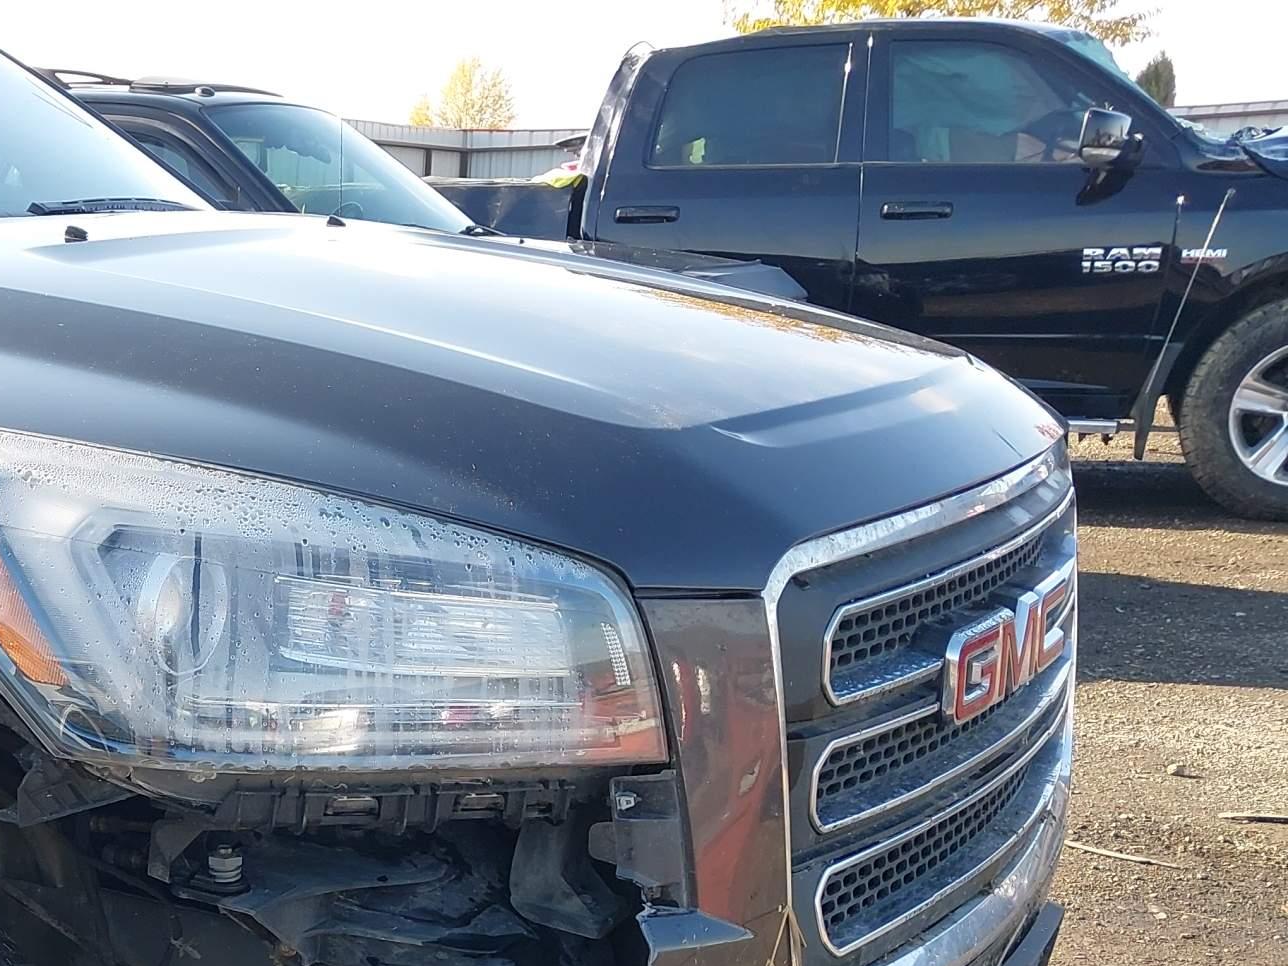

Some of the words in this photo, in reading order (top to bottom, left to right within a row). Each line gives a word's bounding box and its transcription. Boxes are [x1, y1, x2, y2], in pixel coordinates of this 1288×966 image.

[1082, 247, 1163, 260] RAM
[1081, 260, 1160, 273] 1500
[943, 571, 1066, 726] GMC
